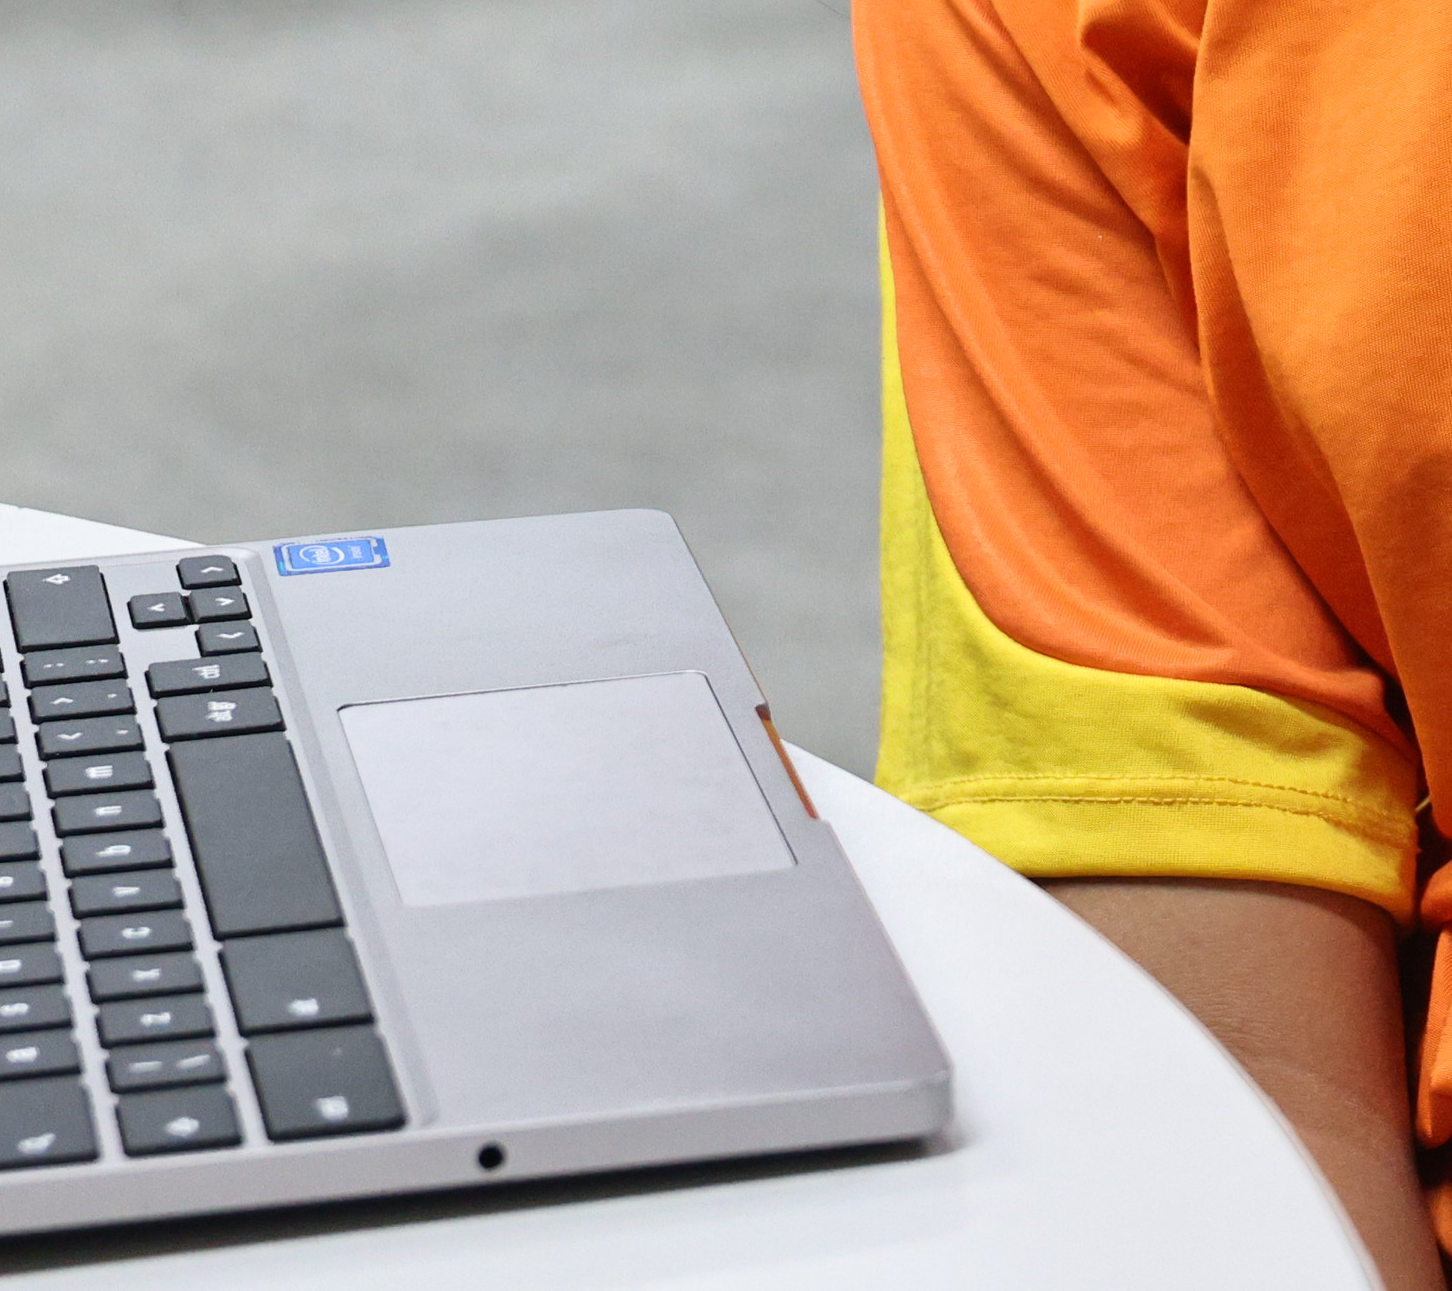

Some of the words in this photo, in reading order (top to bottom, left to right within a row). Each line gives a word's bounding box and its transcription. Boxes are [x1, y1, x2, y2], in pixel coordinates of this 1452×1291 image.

[192, 665, 220, 679] ctrl
[85, 765, 113, 779] m
[93, 806, 122, 816] n
[96, 845, 131, 857] b
[113, 887, 140, 896] v
[121, 927, 152, 938] c
[132, 968, 160, 981] x
[140, 1012, 171, 1026] z
[5, 1047, 38, 1063] a
